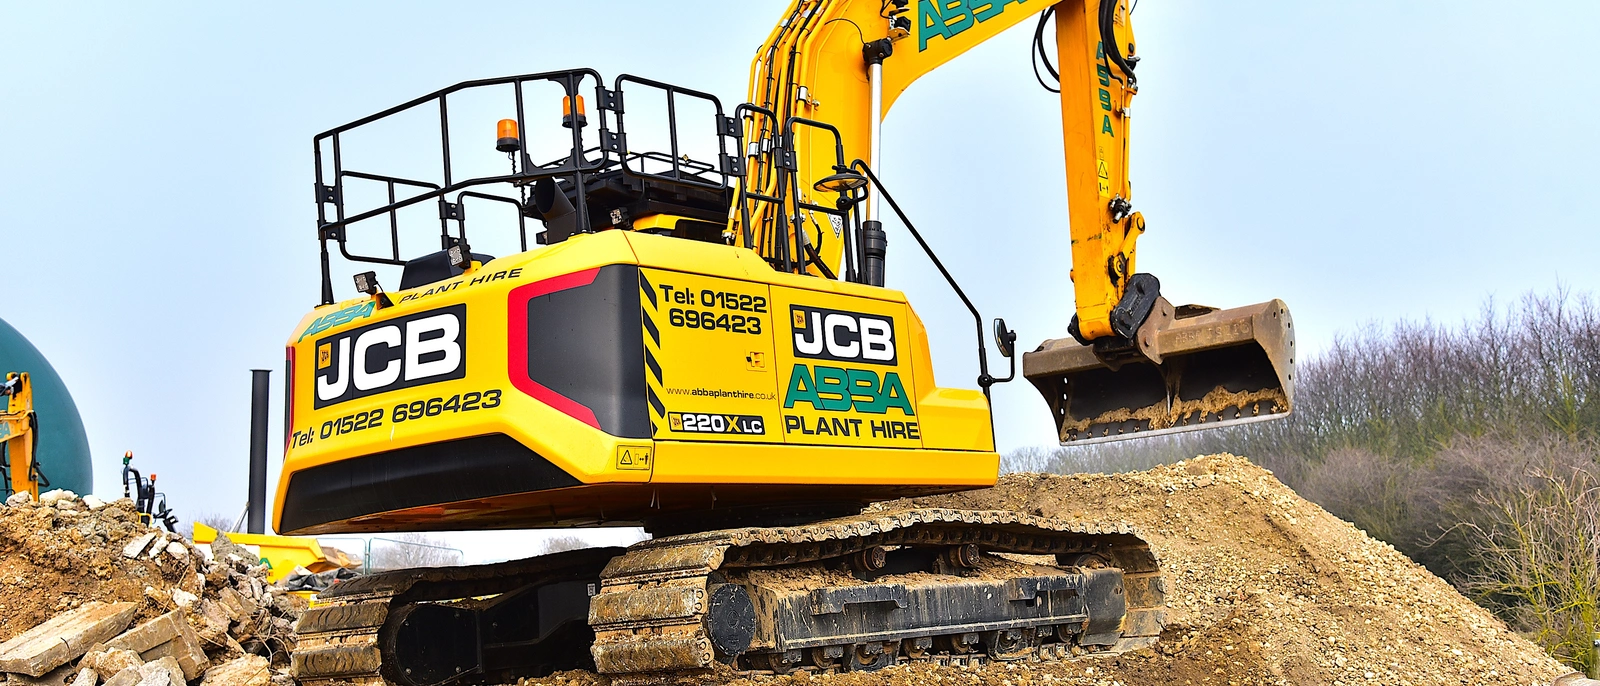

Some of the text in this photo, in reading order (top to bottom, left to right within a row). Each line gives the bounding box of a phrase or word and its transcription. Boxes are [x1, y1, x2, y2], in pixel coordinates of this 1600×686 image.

[399, 268, 523, 304] PLANT HIRE
[659, 284, 767, 313] Tel: 01522
[298, 301, 376, 343] ABBA
[669, 308, 761, 335] 696423
[794, 311, 895, 361] JCB
[317, 313, 461, 401] JCB
[666, 387, 777, 401] www.abbaplanthire.co.uk
[783, 363, 915, 416] ABBA
[292, 389, 502, 449] Tel: 01522 696423
[784, 415, 920, 439] PLANT HIRE
